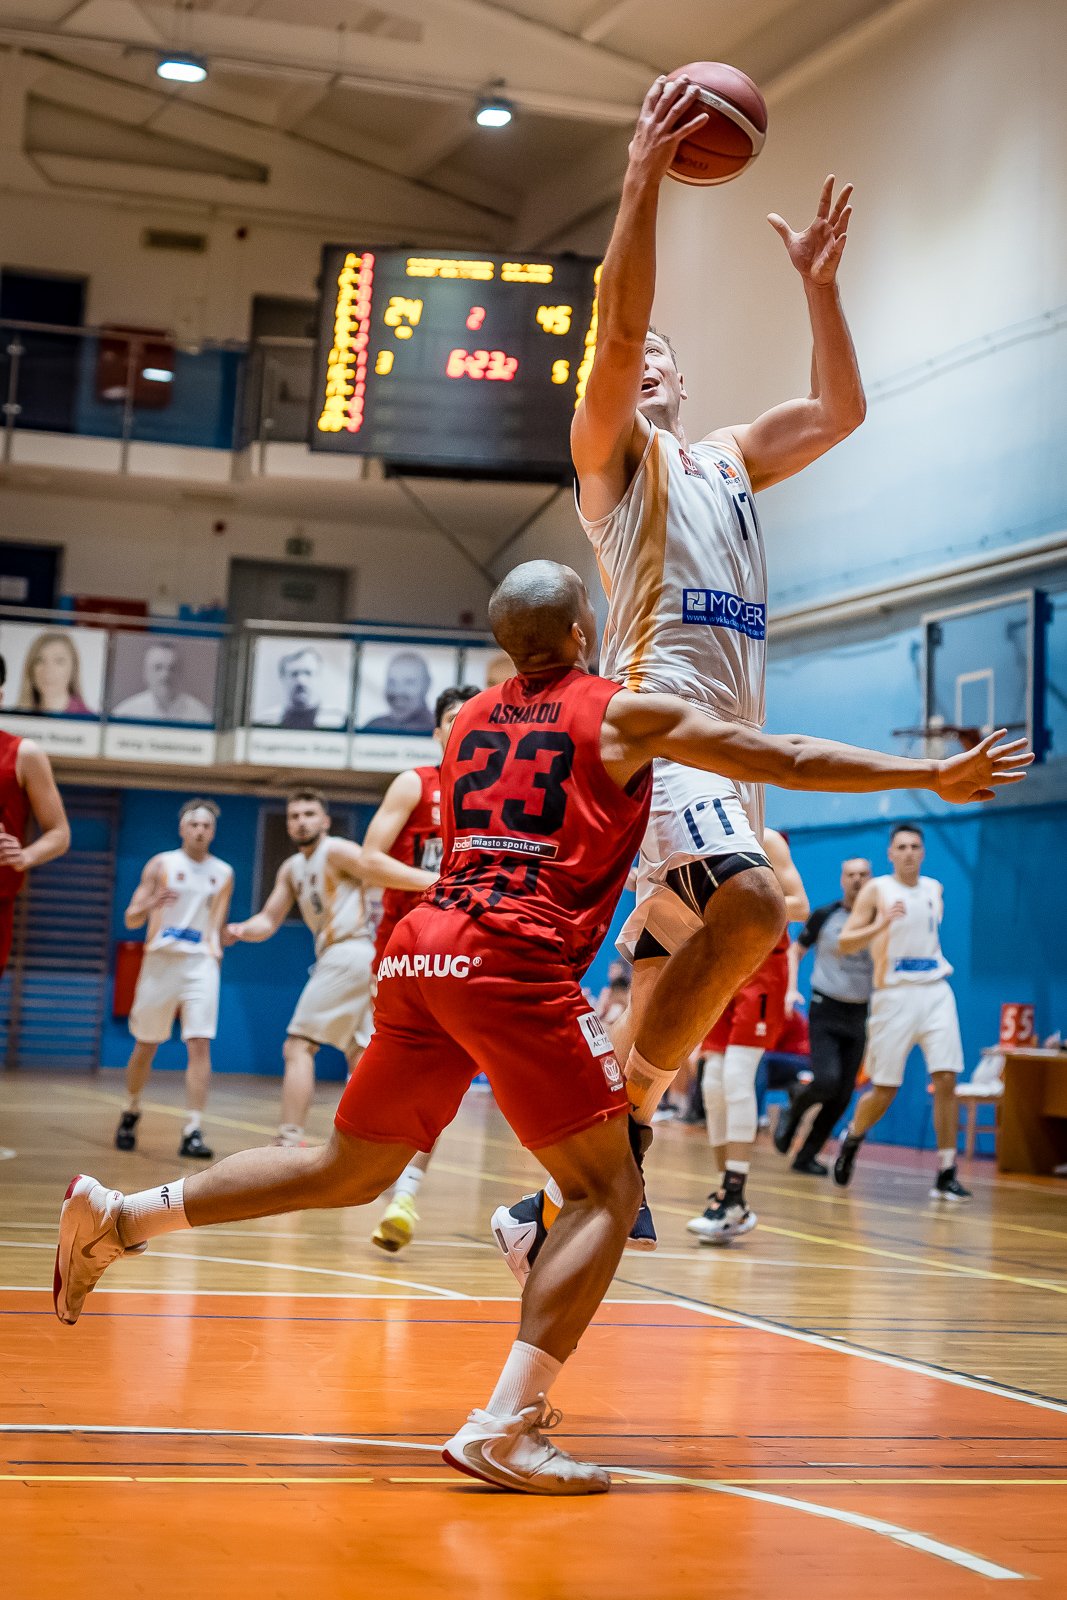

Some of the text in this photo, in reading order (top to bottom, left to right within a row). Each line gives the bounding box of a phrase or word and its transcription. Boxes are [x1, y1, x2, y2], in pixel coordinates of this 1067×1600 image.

[488, 702, 562, 724] ASHALOU
[453, 729, 576, 836] 23
[683, 798, 735, 850] 17
[472, 838, 501, 847] miasto
[502, 840, 541, 852] spotkań
